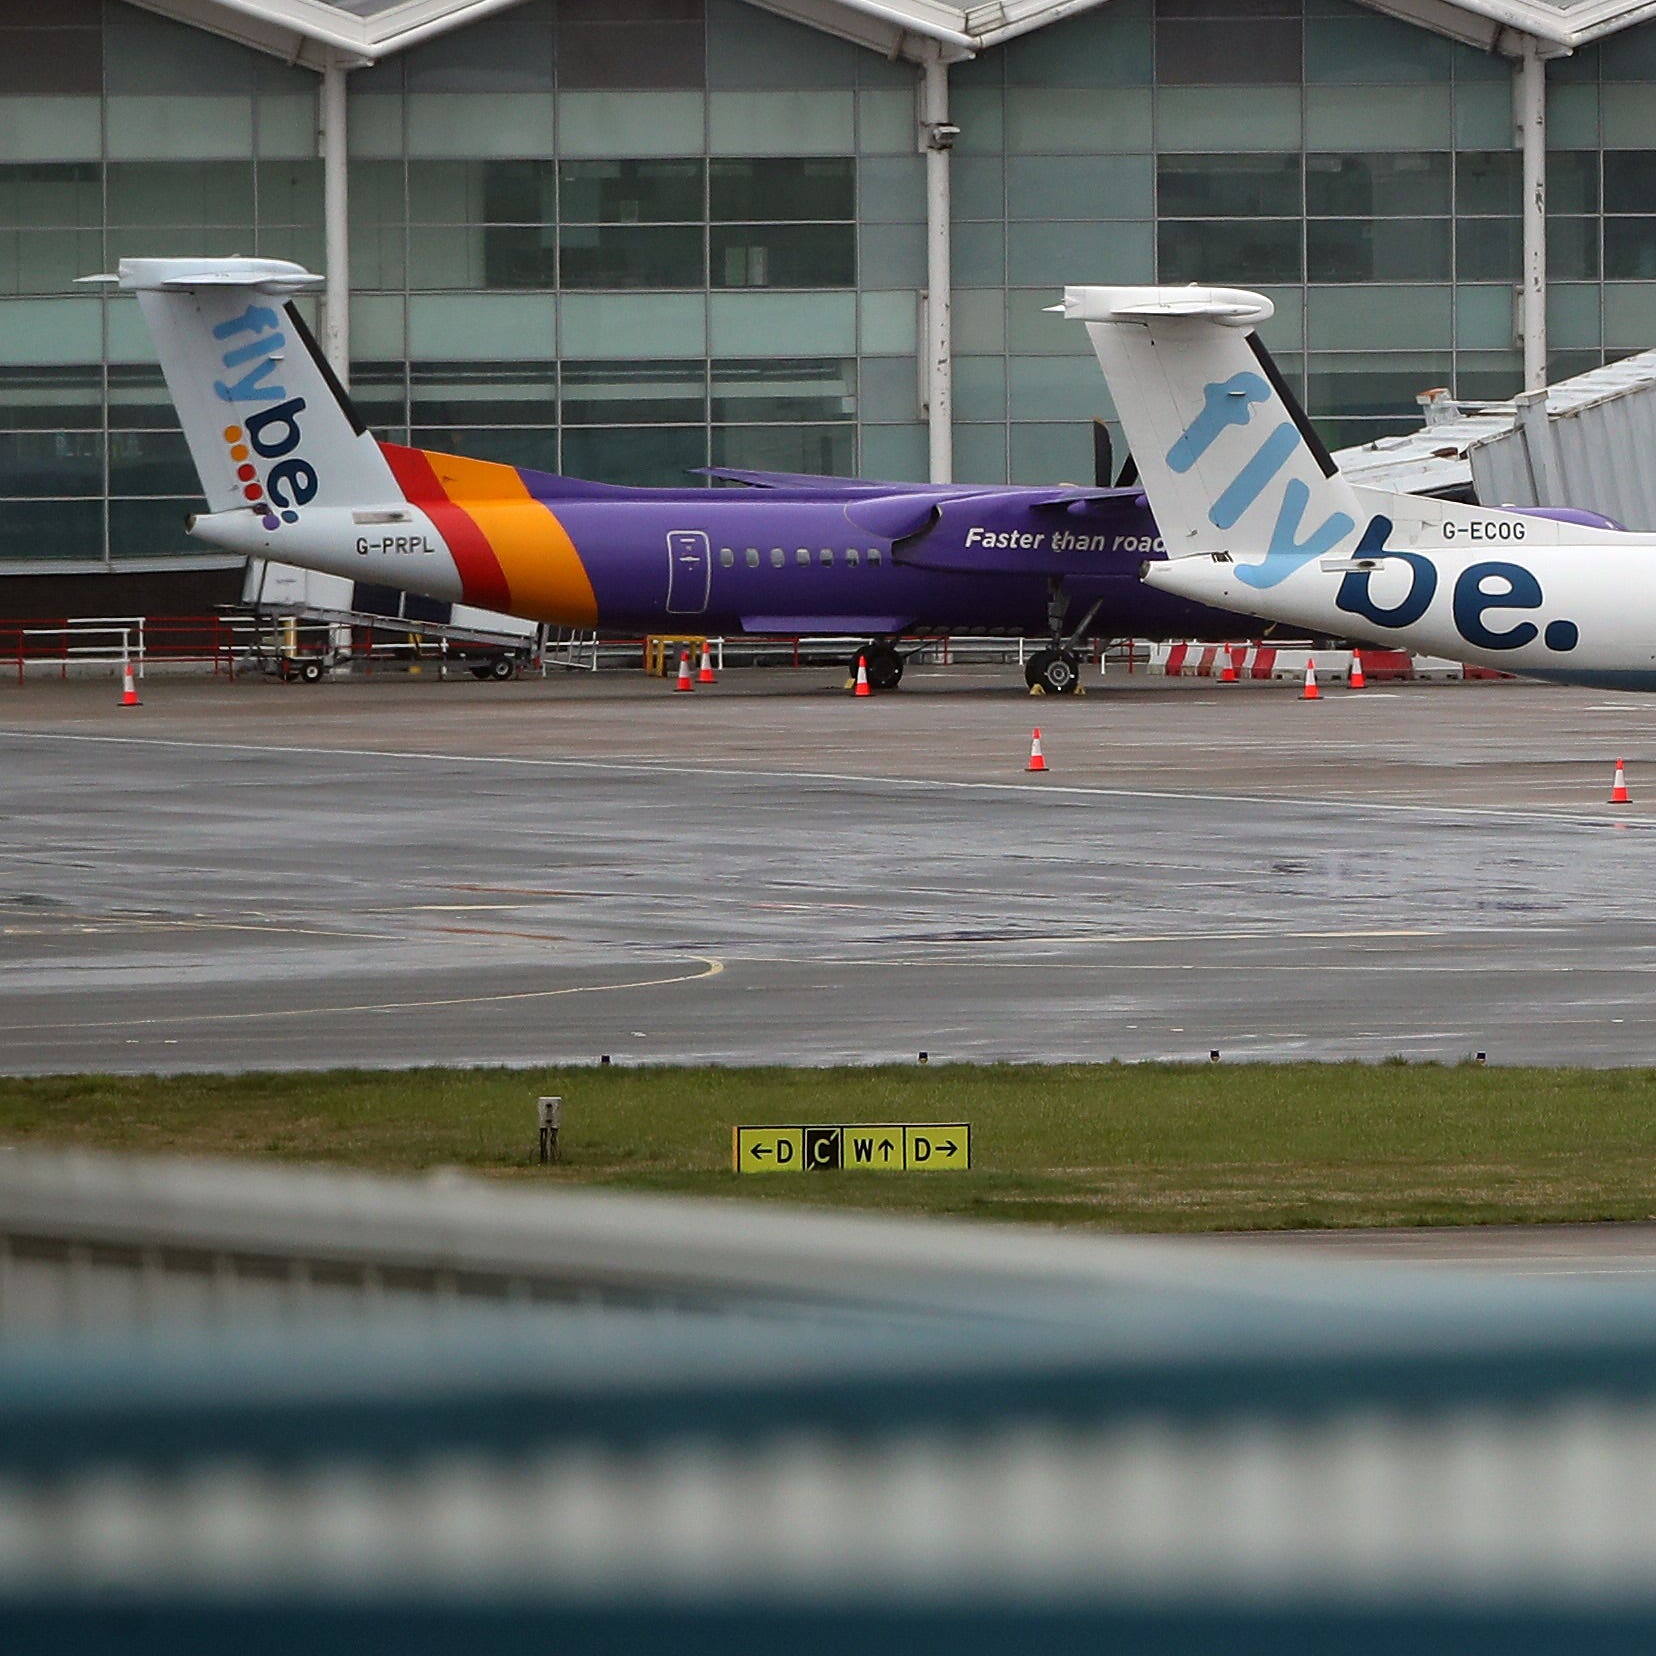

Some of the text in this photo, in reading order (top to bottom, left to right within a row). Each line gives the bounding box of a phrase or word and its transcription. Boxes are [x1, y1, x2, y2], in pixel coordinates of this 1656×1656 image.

[1166, 371, 1355, 590] fly
[964, 527, 1045, 550] Faster
[1051, 531, 1105, 552] than
[1442, 520, 1526, 541] G-ECOG
[356, 536, 436, 556] G-PRPL
[776, 1137, 931, 1164] D C W D
